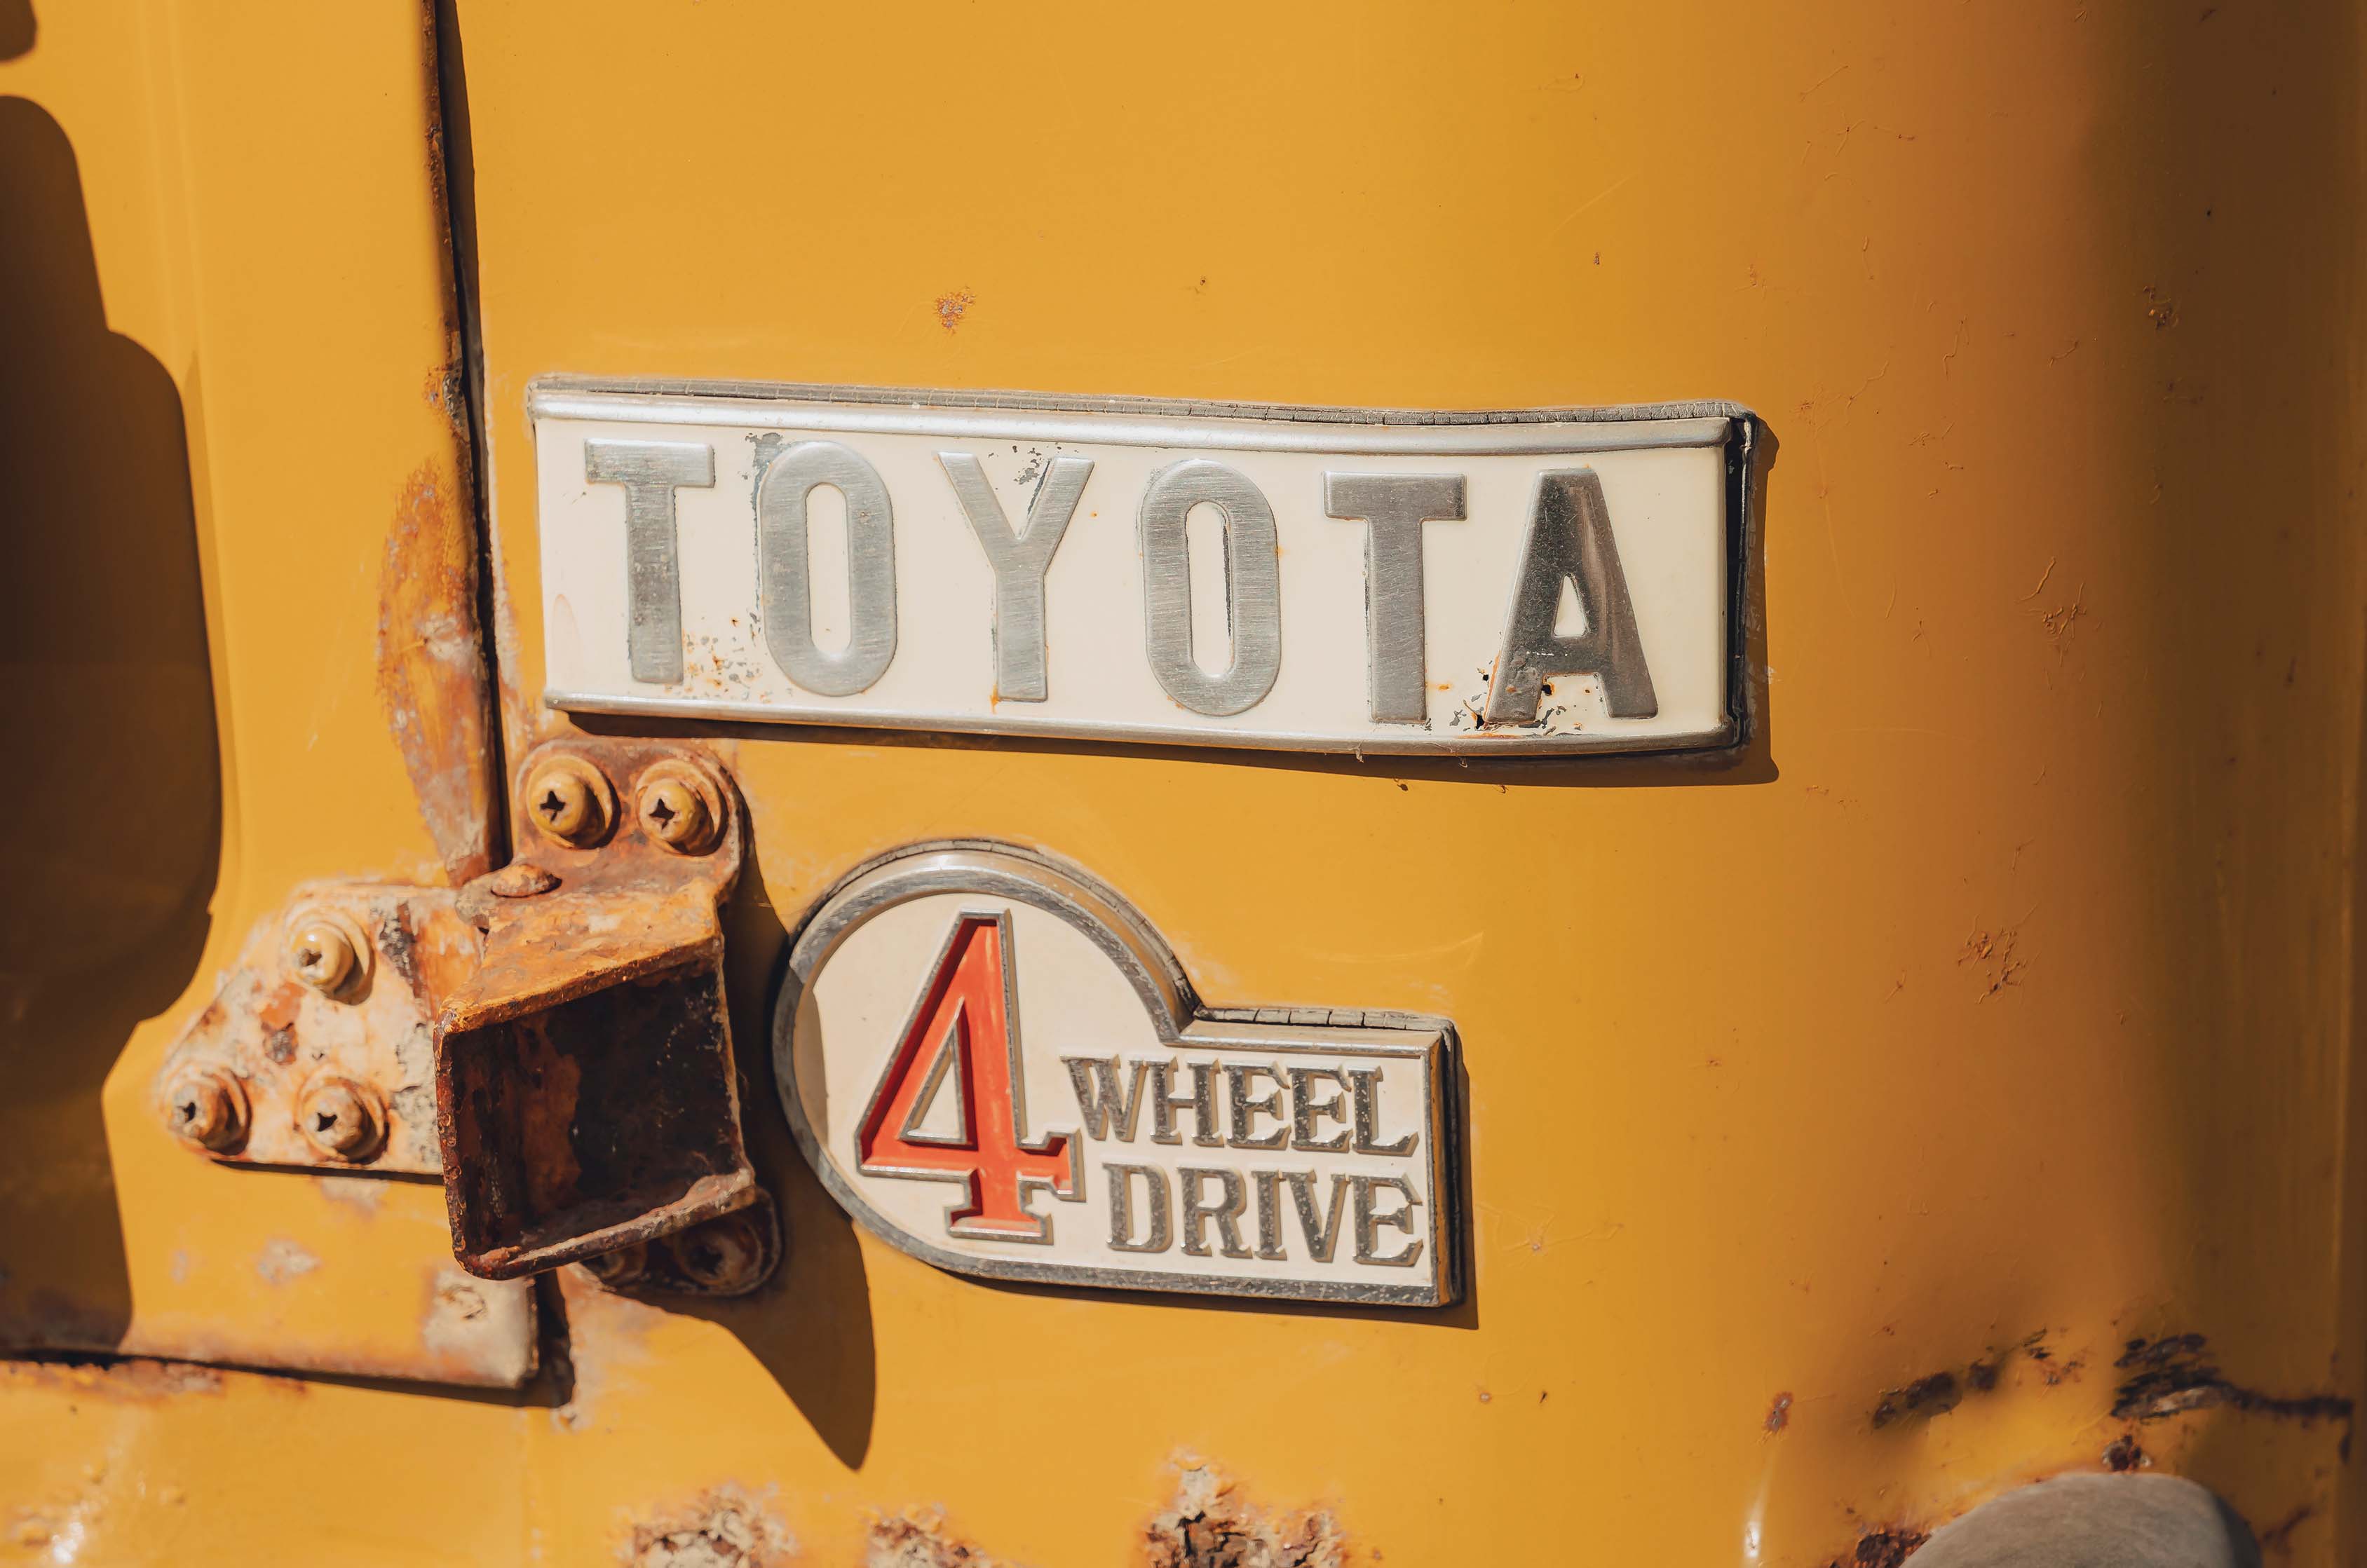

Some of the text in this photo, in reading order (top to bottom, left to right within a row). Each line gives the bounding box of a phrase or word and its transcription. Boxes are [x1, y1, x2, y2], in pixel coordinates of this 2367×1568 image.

[585, 438, 1657, 725] TOYOTA
[855, 909, 1419, 1244] 4 WHEEL
[1101, 1162, 1423, 1266] DRIVE
